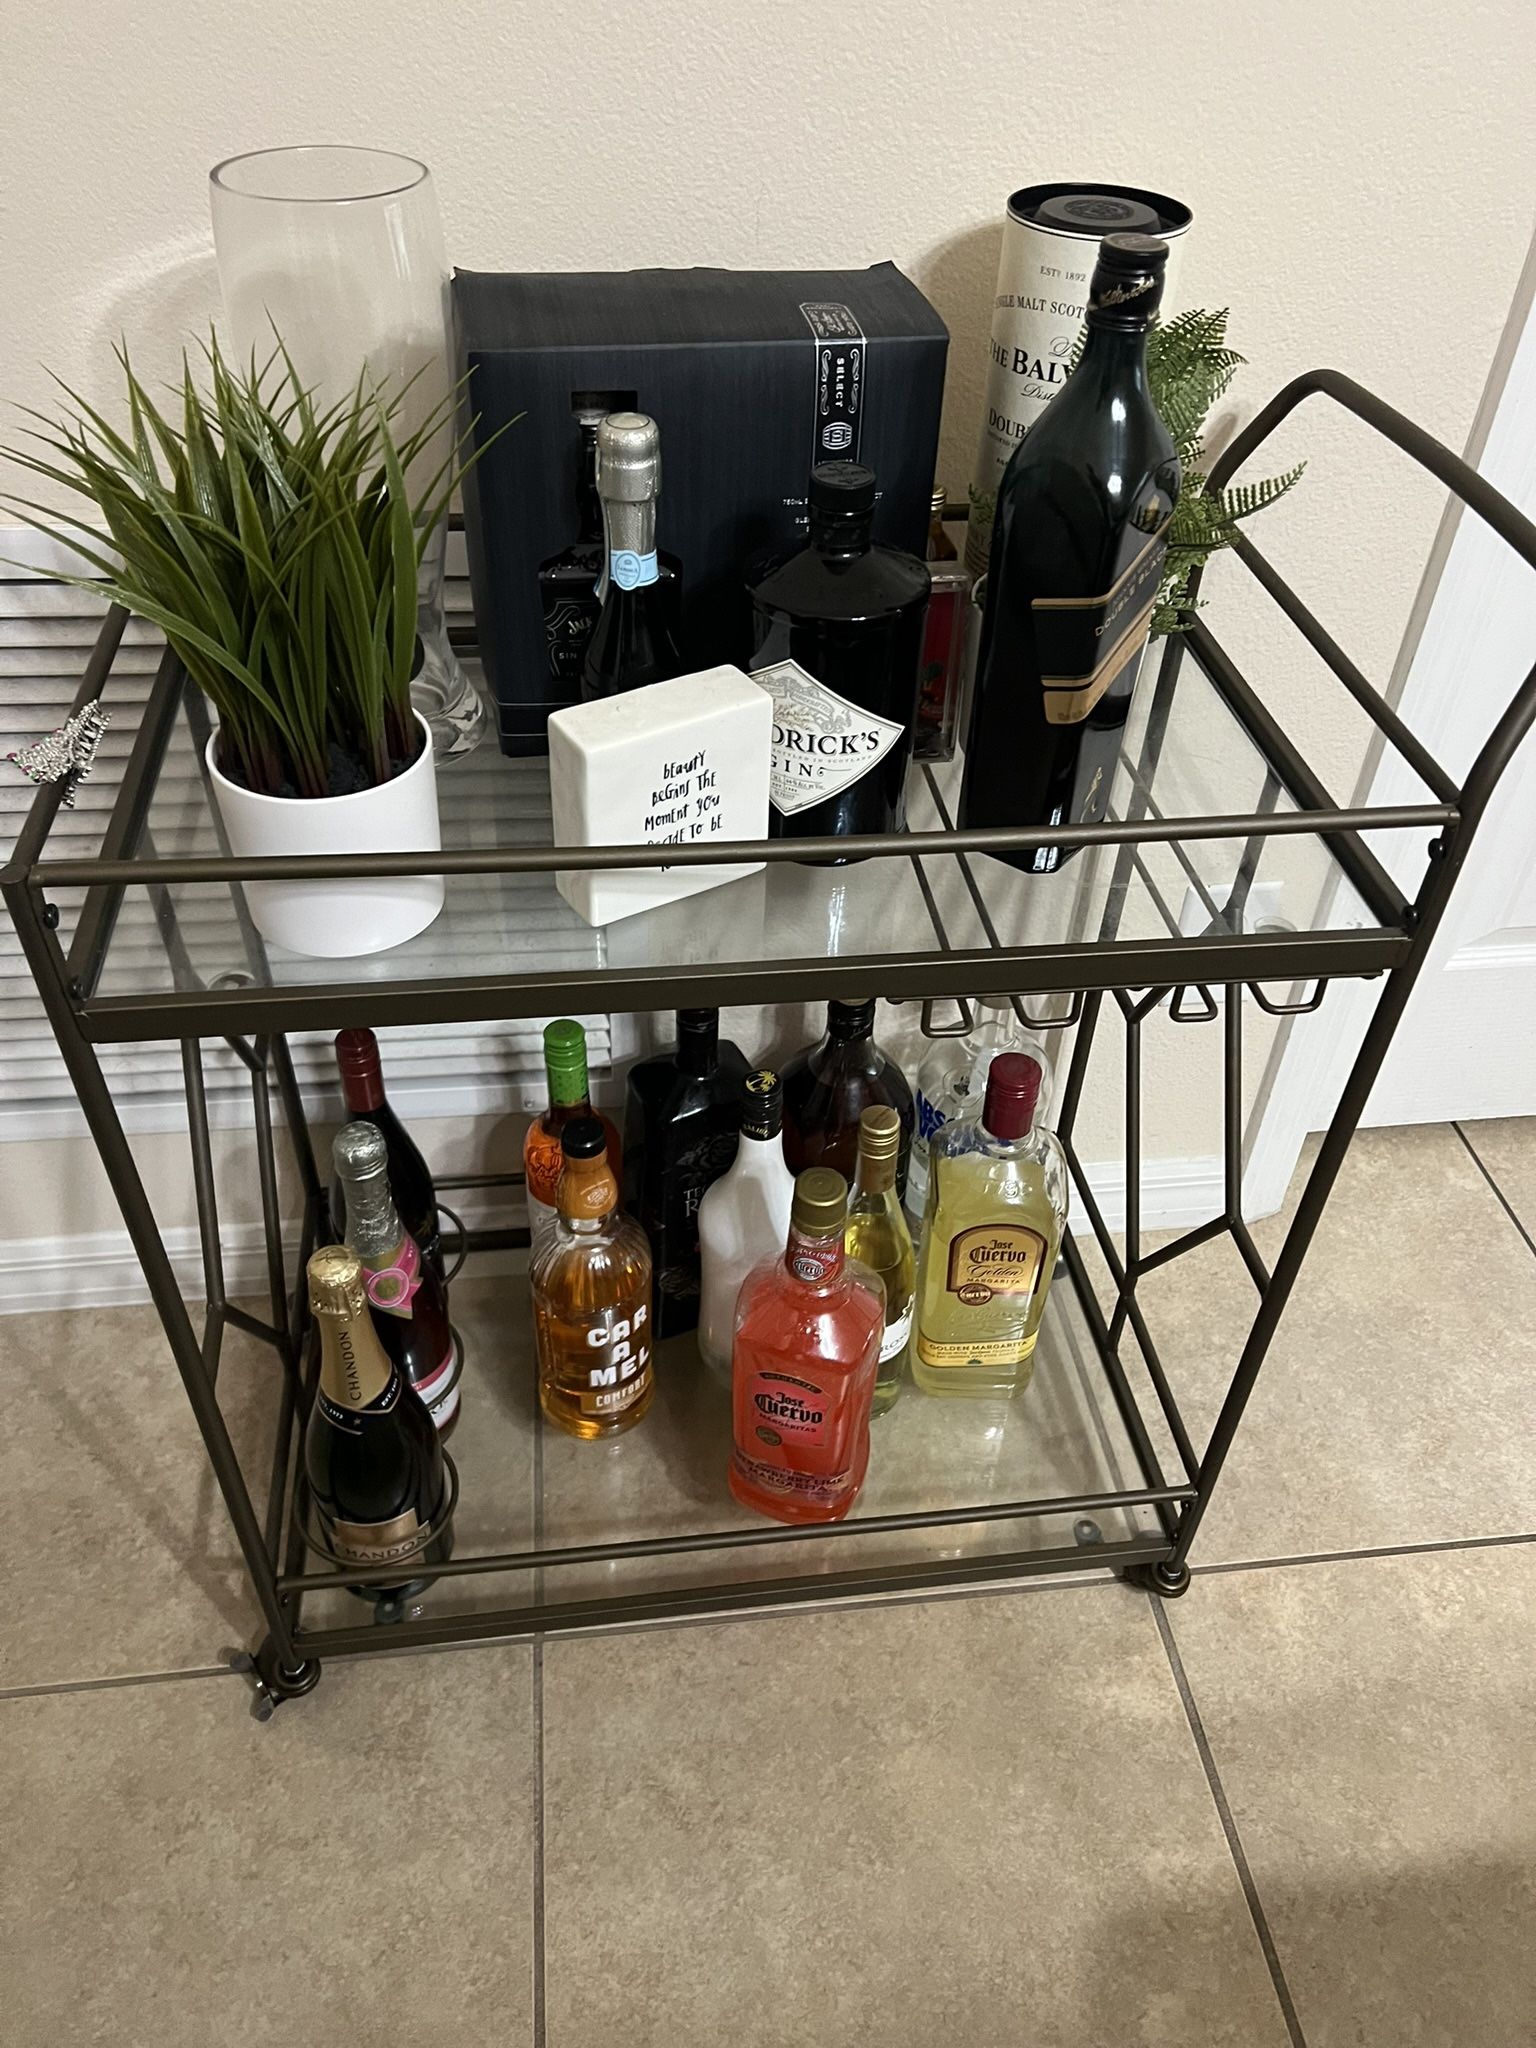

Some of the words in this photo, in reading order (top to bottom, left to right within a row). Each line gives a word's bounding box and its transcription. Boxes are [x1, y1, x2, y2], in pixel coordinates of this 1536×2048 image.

[1065, 272, 1087, 281] 1892
[1017, 296, 1047, 312] MALT
[1049, 301, 1085, 319] SCOT
[991, 338, 1009, 368] THE
[835, 357, 845, 407] SELECT
[1020, 382, 1055, 401] Dist
[989, 407, 1031, 439] DOUB
[1095, 584, 1136, 637] DOUBLE
[558, 651, 577, 660] SIN
[771, 723, 882, 756] DRICK'S
[969, 1245, 1027, 1265] Cuervo
[989, 1239, 1014, 1251] Jose
[966, 1264, 1024, 1278] Golden
[587, 1304, 647, 1348] CAR
[612, 1340, 630, 1365] A
[929, 1344, 970, 1352] GOLDEN
[971, 1340, 1028, 1351] MARGARITA
[339, 1331, 363, 1401] CHANDON
[589, 1346, 650, 1388] MEL
[595, 1371, 647, 1408] COMFORT
[774, 1391, 805, 1408] Jose
[754, 1393, 823, 1424] Cuervo
